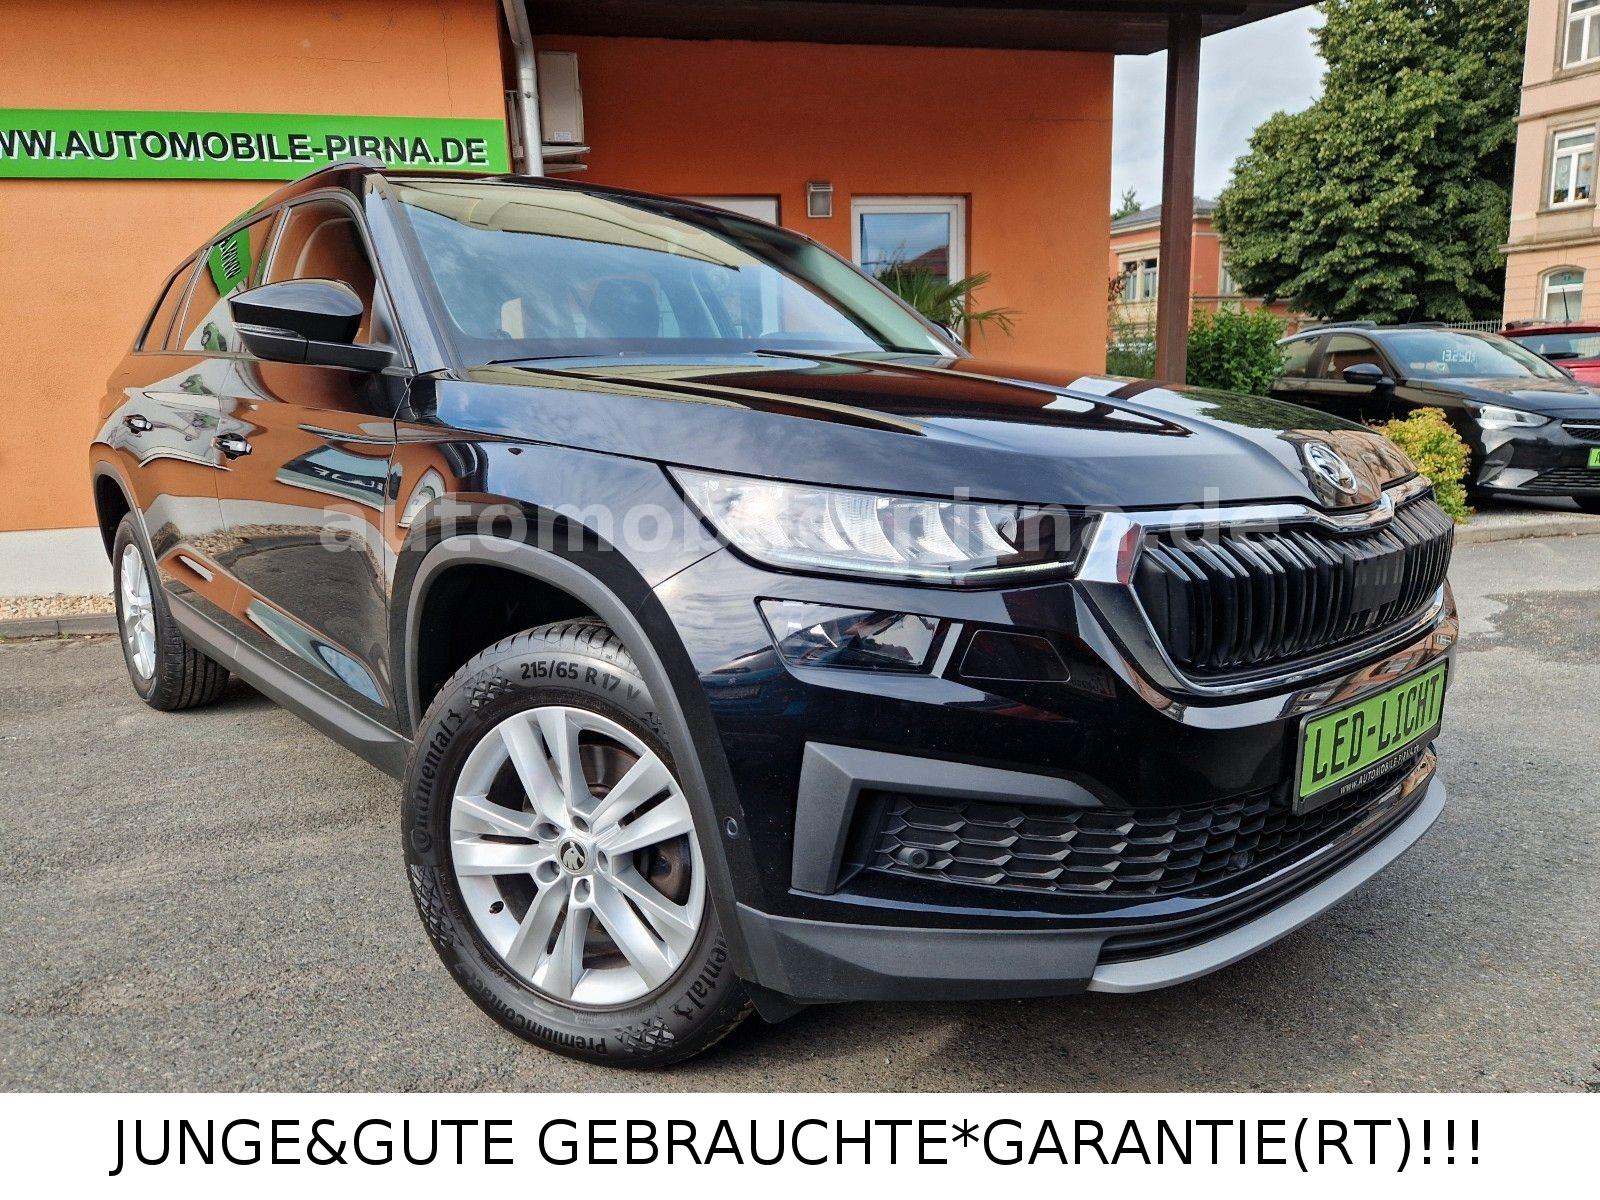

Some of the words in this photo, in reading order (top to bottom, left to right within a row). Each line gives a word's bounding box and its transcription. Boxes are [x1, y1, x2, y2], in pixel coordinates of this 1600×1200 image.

[520, 660, 579, 681] 215/65
[585, 666, 598, 685] R
[602, 673, 621, 691] 17
[1311, 673, 1440, 784] LED-LICHT
[410, 720, 454, 854] Continental
